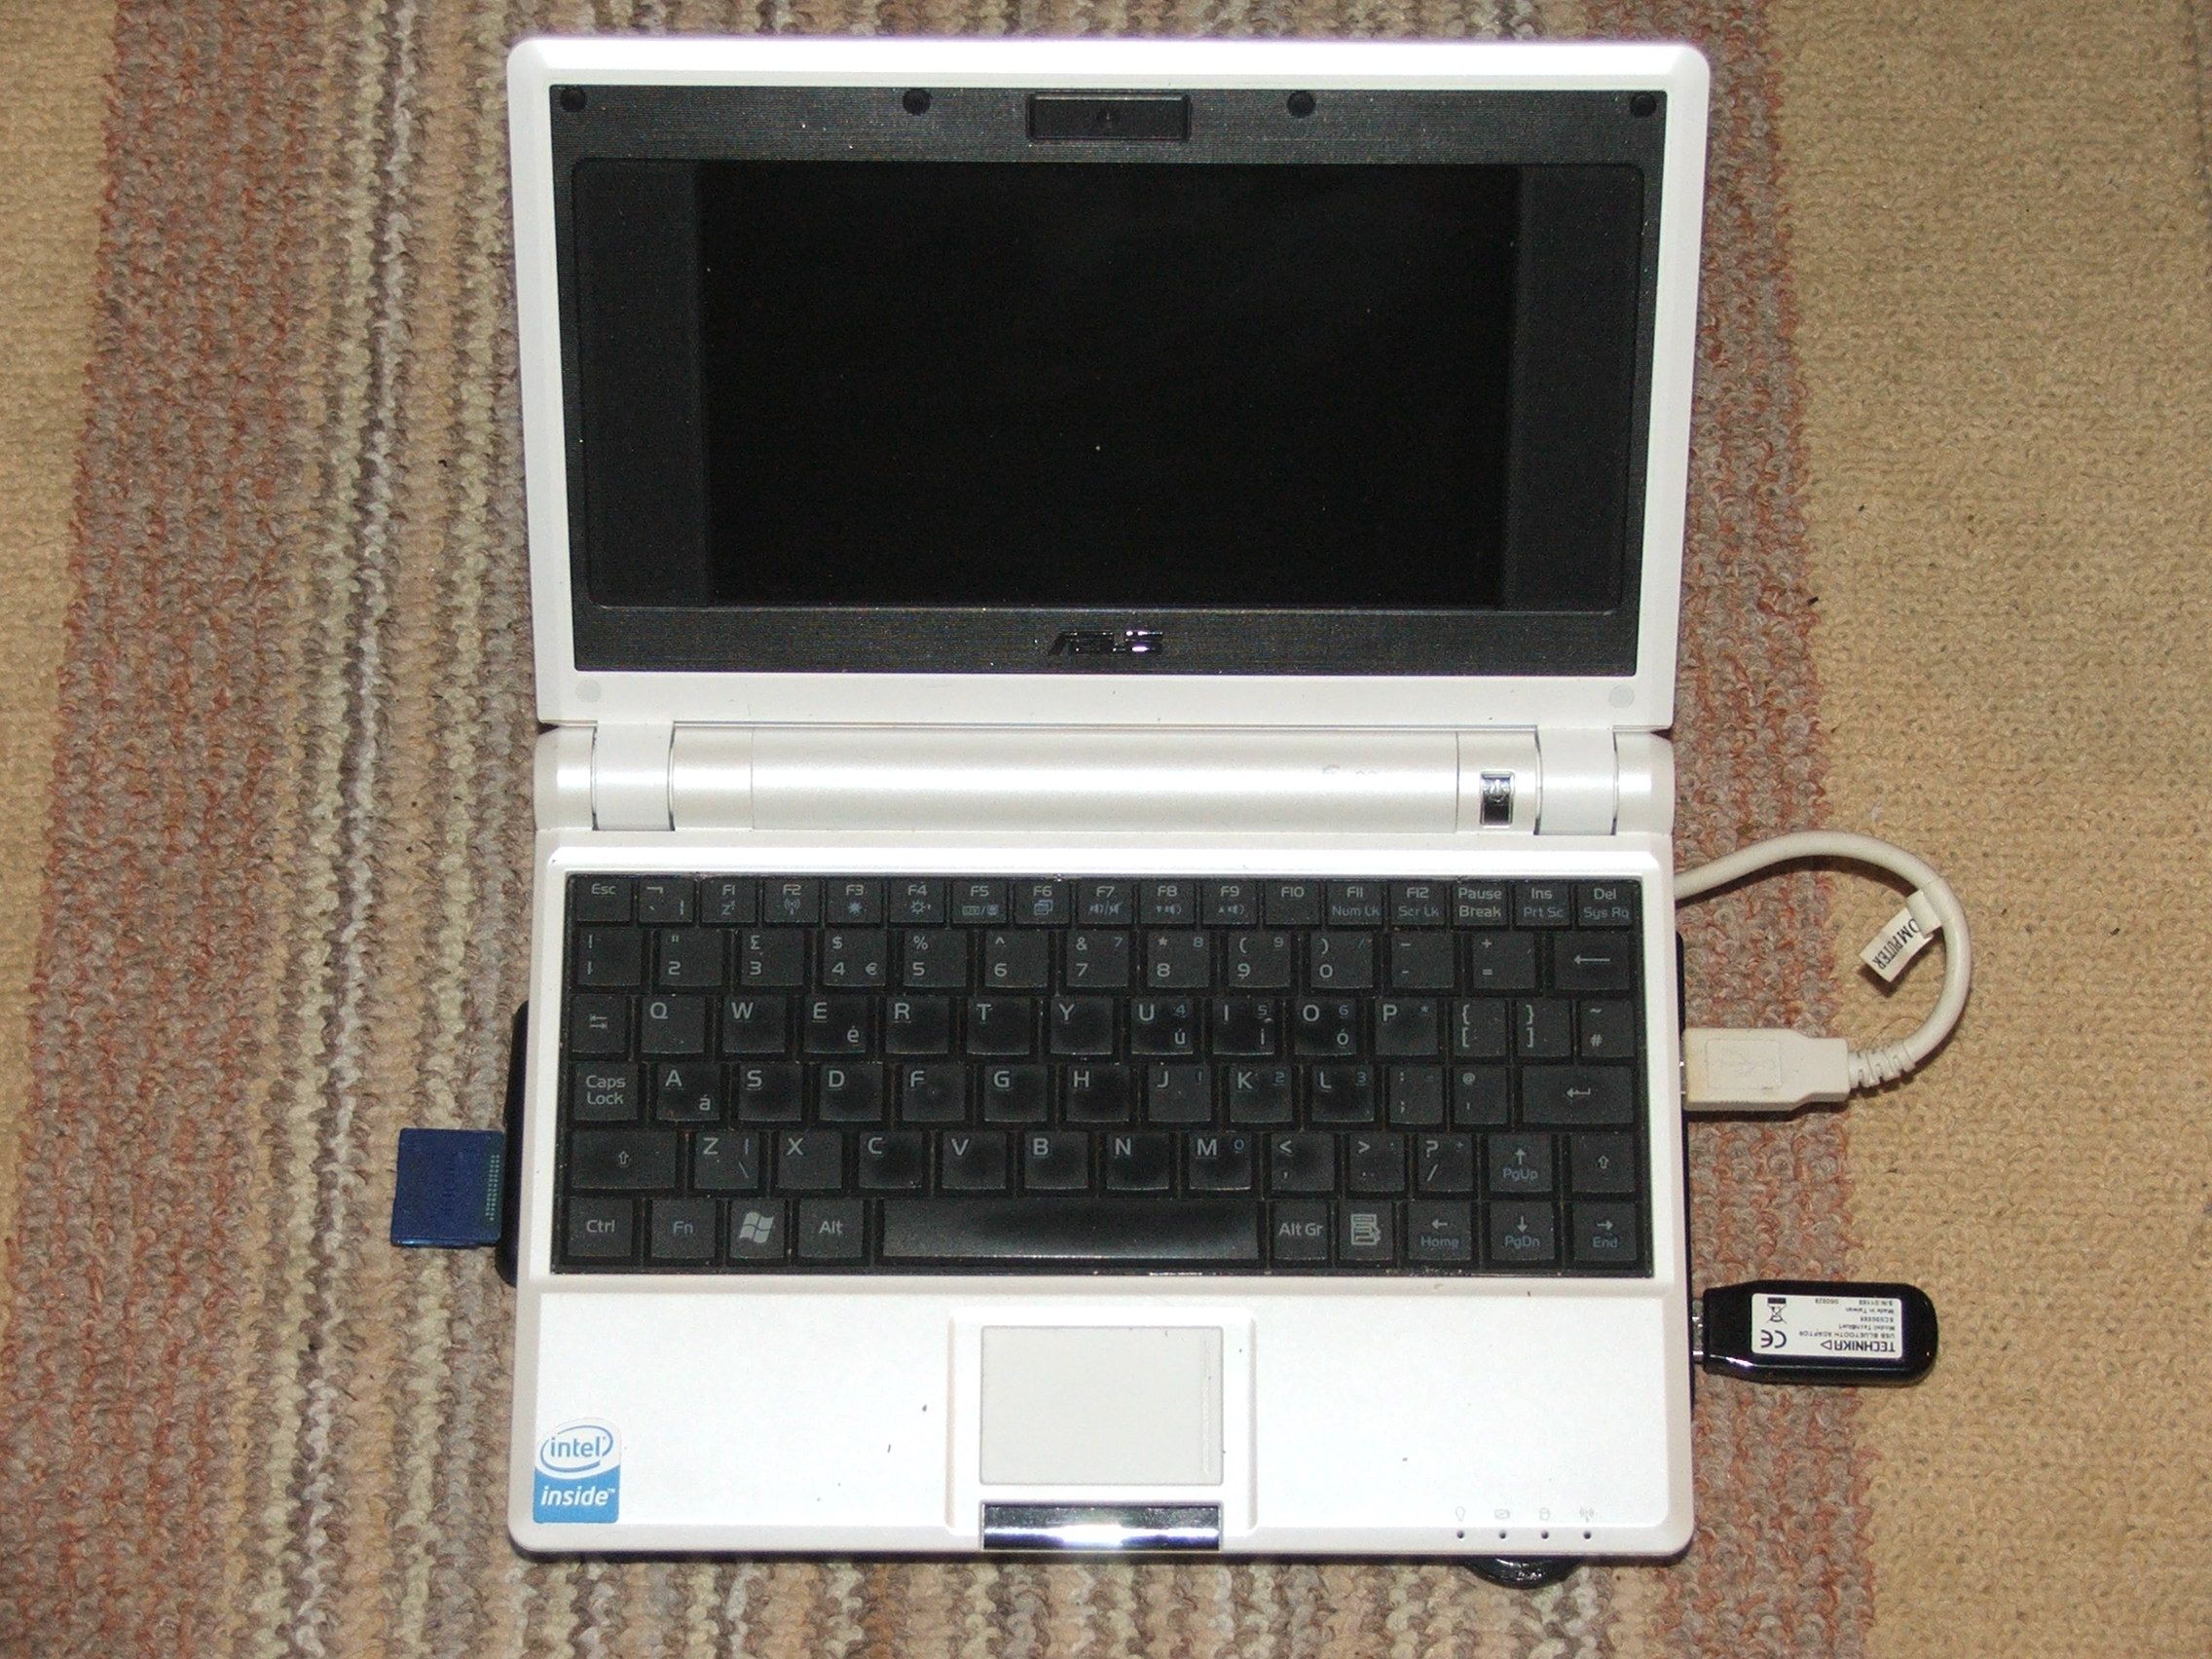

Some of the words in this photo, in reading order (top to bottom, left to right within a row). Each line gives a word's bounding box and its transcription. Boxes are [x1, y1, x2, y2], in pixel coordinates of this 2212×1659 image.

[591, 883, 616, 895] Esc
[723, 884, 736, 896] F1
[783, 884, 801, 896] F2
[845, 884, 865, 896] F3
[907, 885, 927, 896] F4
[971, 885, 989, 897] F5
[1033, 885, 1052, 897] F6
[1095, 886, 1115, 897] F7
[1157, 886, 1178, 897] F8
[1220, 886, 1240, 897] F9
[1280, 886, 1305, 898] F10
[1346, 886, 1364, 898] F11
[1406, 887, 1429, 899] F12
[1458, 887, 1502, 900] Pause
[1530, 887, 1553, 900] Ins
[1593, 888, 1616, 900] Del
[1331, 905, 1361, 917] Num
[1364, 905, 1381, 917] Lk
[1398, 906, 1420, 917] Scr
[1423, 906, 1439, 917] Lk
[1459, 905, 1502, 917] Break
[1524, 906, 1544, 918] Prt
[1547, 906, 1565, 918] Sc
[1583, 906, 1607, 920] Sys
[1611, 907, 1630, 919] Rq
[832, 937, 843, 949] $
[913, 936, 929, 950] %
[1076, 937, 1088, 950] &
[1193, 938, 1203, 947] 8
[1239, 938, 1247, 953] (
[1273, 938, 1284, 947] 9
[1321, 939, 1329, 954] )
[1482, 939, 1493, 948] +
[669, 961, 681, 975] 2
[750, 961, 761, 975] 3
[832, 962, 845, 975] 4
[866, 963, 878, 975] €
[913, 962, 925, 976] 5
[994, 963, 1008, 977] 6
[1076, 963, 1088, 977] 7
[1157, 963, 1170, 977] 8
[1237, 963, 1250, 977] 9
[650, 1003, 668, 1019] Q
[731, 1003, 754, 1019] W
[813, 1003, 828, 1019] E
[895, 1004, 911, 1020] R
[977, 1004, 992, 1020] T
[1059, 1004, 1074, 1020] Y
[1139, 1004, 1155, 1021] U
[1175, 1005, 1186, 1015] 4
[1224, 1005, 1229, 1021] I
[1257, 1005, 1268, 1015] 5
[1303, 1005, 1319, 1021] O
[1339, 1005, 1348, 1015] 6
[1383, 1004, 1397, 1021] P
[1461, 1005, 1470, 1024] {
[1526, 1005, 1534, 1024] }
[1462, 1027, 1470, 1048] [
[1527, 1027, 1534, 1048] ]
[1590, 1034, 1603, 1047] #
[586, 1075, 626, 1090] Caps
[666, 1070, 682, 1087] A
[747, 1070, 762, 1088] S
[829, 1071, 845, 1088] D
[910, 1071, 925, 1088] F
[994, 1071, 1010, 1088] G
[1074, 1071, 1089, 1088] H
[1158, 1071, 1168, 1088] J
[1237, 1072, 1253, 1088] K
[1274, 1073, 1285, 1083] 2
[1320, 1072, 1332, 1088] L
[1357, 1072, 1366, 1083] 3
[1462, 1073, 1476, 1086] @
[586, 1092, 623, 1105] Lock
[703, 1138, 719, 1155] Z
[787, 1138, 804, 1156] X
[867, 1137, 883, 1155] C
[951, 1139, 970, 1156] V
[1034, 1138, 1049, 1156] B
[1115, 1138, 1131, 1156] N
[1197, 1139, 1217, 1157] M
[1279, 1140, 1292, 1154] <
[1358, 1141, 1370, 1154] >
[1425, 1140, 1438, 1159] ?
[1427, 1163, 1438, 1181] /
[1503, 1168, 1538, 1182] PgUp
[586, 1220, 615, 1234] Ctrl
[673, 1222, 694, 1234] Fn
[819, 1221, 843, 1235] Alt
[1278, 1223, 1301, 1235] Alt
[1306, 1223, 1323, 1235] Gr
[1420, 1236, 1459, 1248] Home
[1505, 1235, 1540, 1250] PgDn
[1593, 1236, 1618, 1248] End
[1834, 1331, 1879, 1340] BLUETOOTH
[1834, 1341, 1896, 1352] TECHNIKA
[550, 1436, 601, 1457] intel
